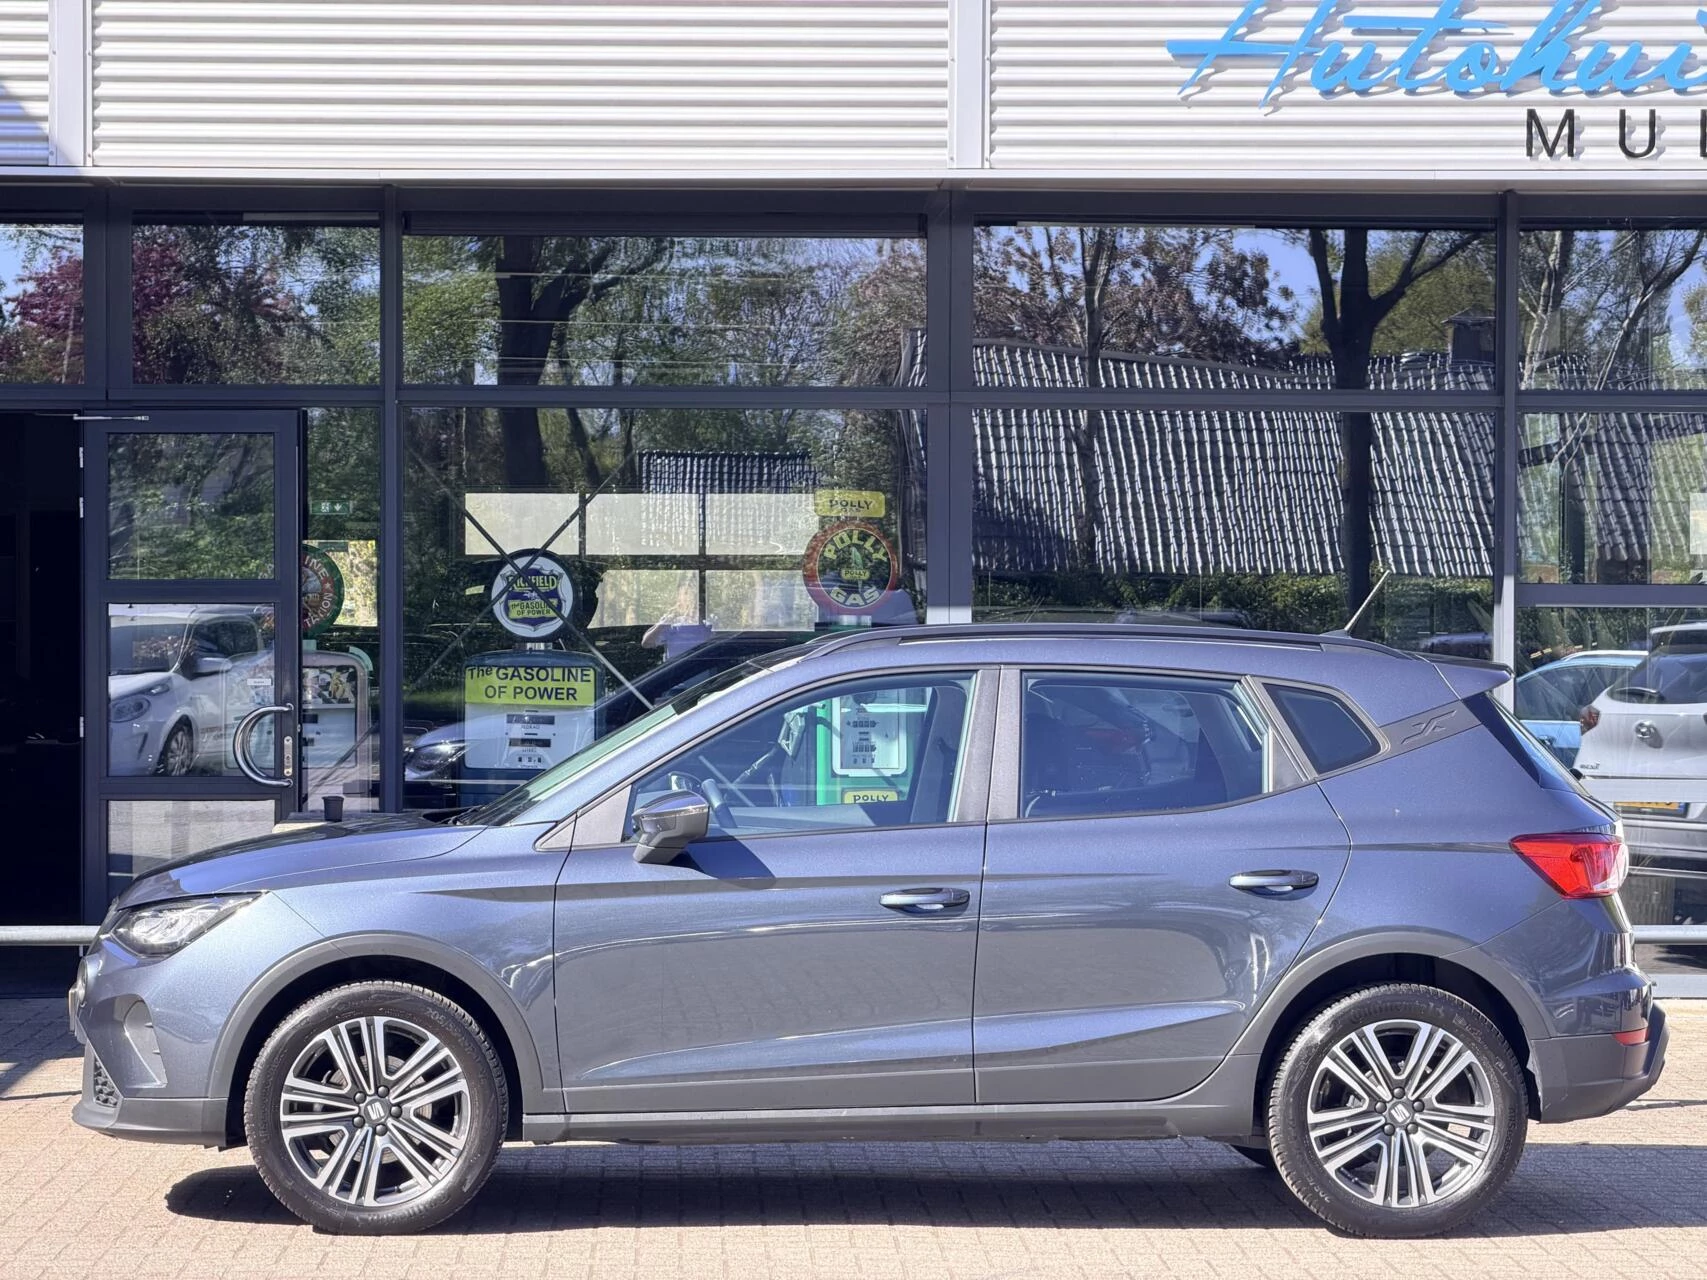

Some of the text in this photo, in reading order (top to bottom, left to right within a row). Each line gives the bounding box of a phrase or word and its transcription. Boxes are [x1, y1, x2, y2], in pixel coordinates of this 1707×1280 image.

[829, 499, 873, 510] POLLY
[823, 529, 888, 561] POLLY
[829, 585, 880, 606] GAS
[468, 666, 591, 683] The GASOLINE
[484, 685, 577, 701] OF POWER
[854, 794, 889, 804] POLLY
